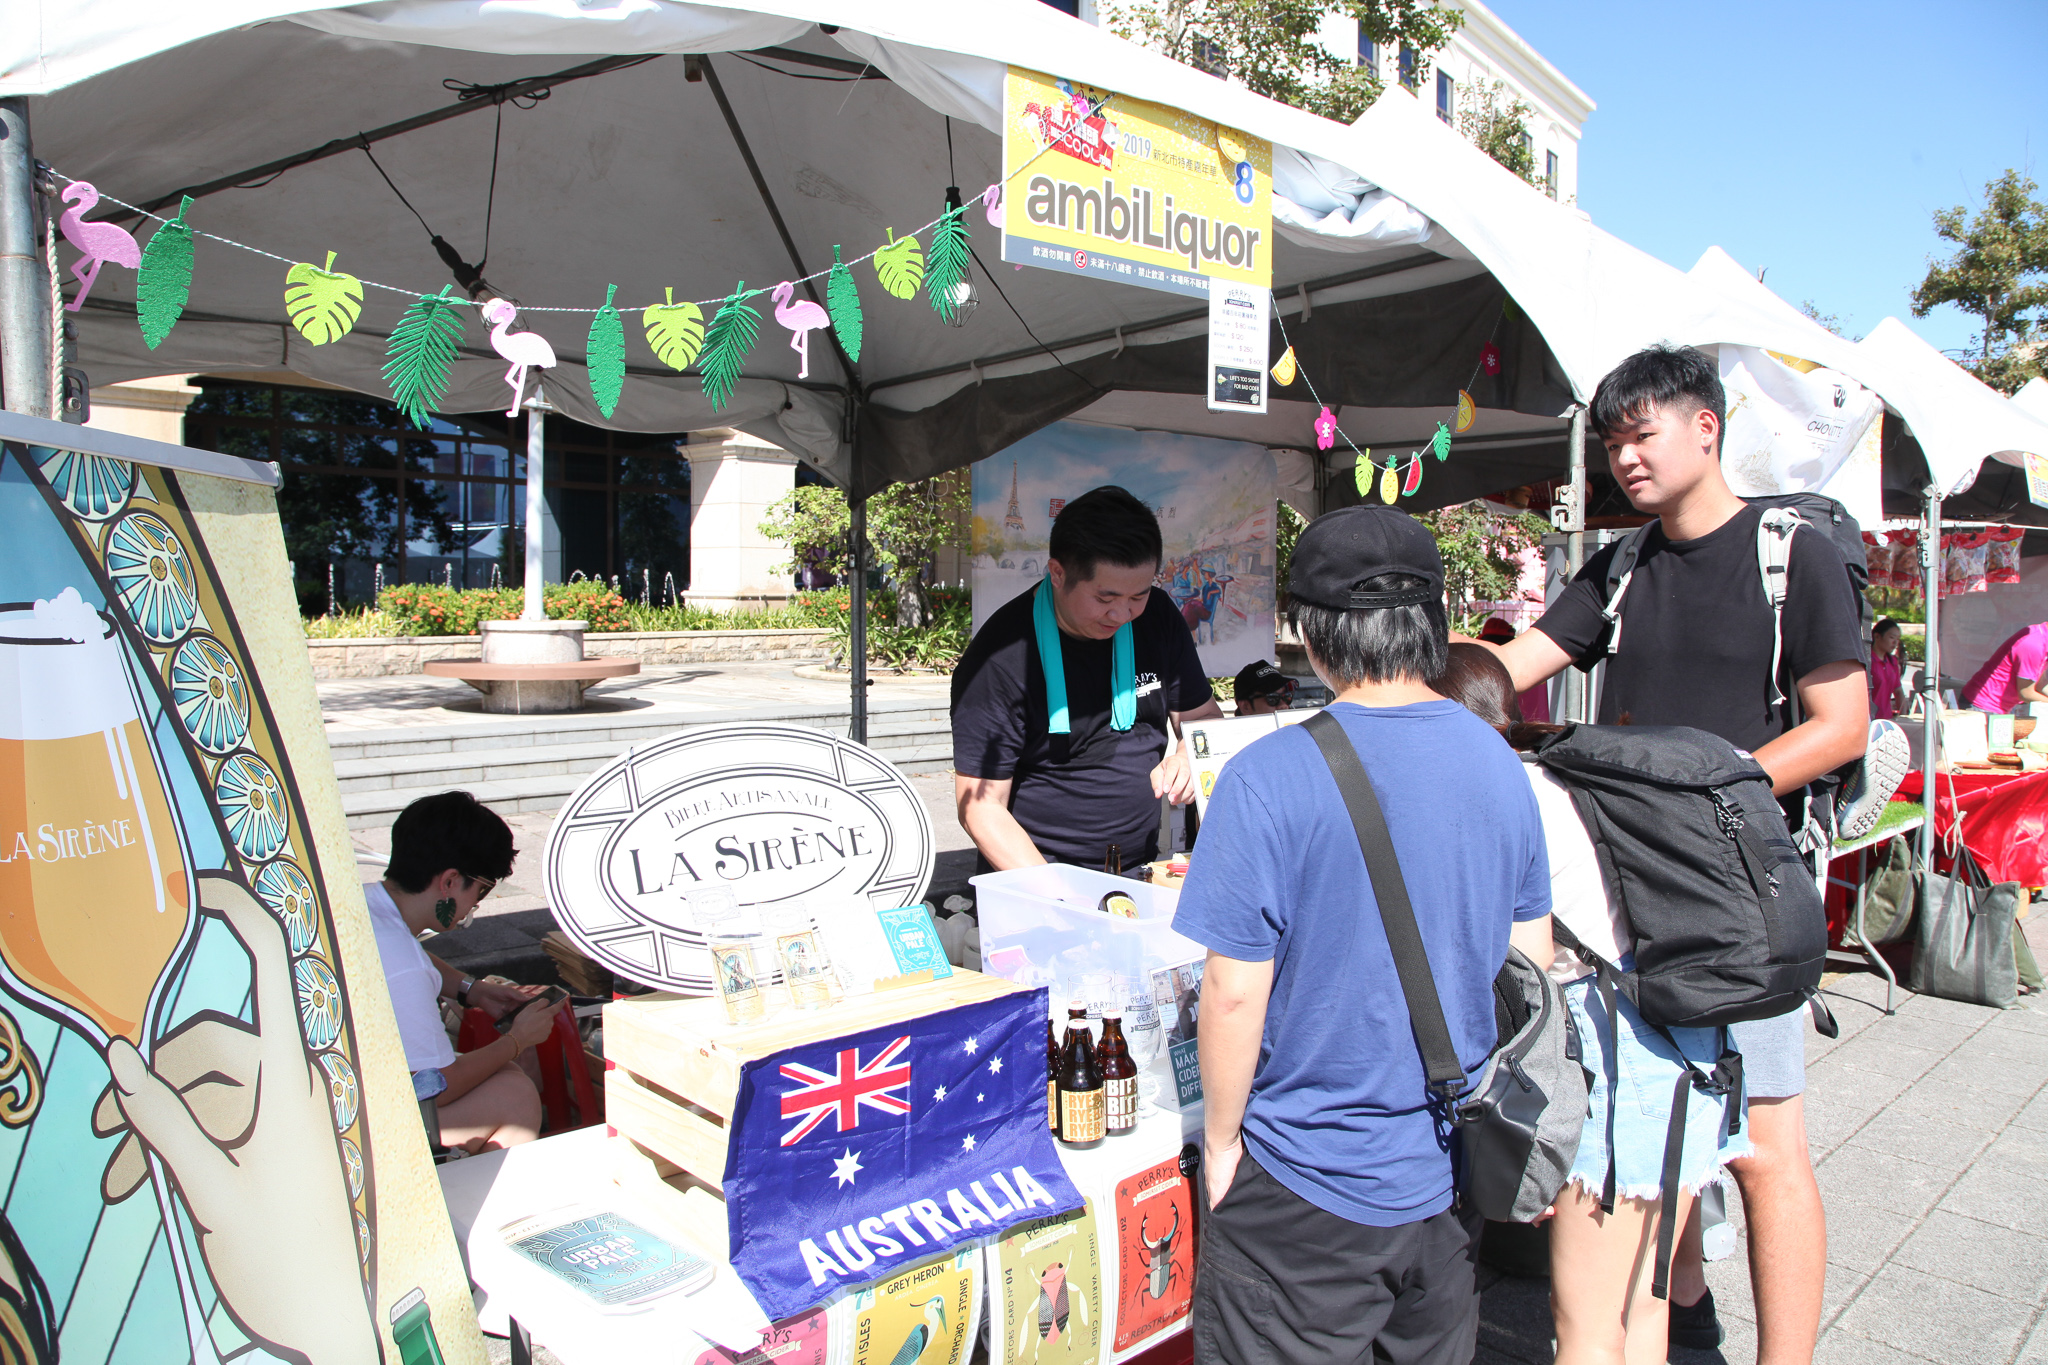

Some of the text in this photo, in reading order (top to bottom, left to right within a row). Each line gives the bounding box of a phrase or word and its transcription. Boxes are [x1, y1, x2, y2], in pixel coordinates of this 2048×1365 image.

[1124, 133, 1217, 177] 2019 新北市特產嘉年華
[1236, 161, 1254, 204] 8
[1027, 176, 1259, 270] ambiLiquor
[1032, 245, 1072, 264] 飲酒勿開車
[719, 789, 833, 811] ARTISANALE
[37, 819, 137, 863] SIRÈNE
[630, 824, 873, 896] LA SIRÈNE
[898, 930, 926, 942] URBAN
[904, 938, 926, 950] PALE
[1178, 1152, 1199, 1169] taste
[1138, 1166, 1174, 1191] PERRY'S
[1139, 1179, 1174, 1200] SOMERSET CIDER
[799, 1165, 1056, 1288] AUSTRALIA
[1025, 1213, 1069, 1241] PERRY'S
[1120, 1216, 1128, 1233] 02
[561, 1235, 637, 1264] URBAN
[582, 1244, 643, 1270] PALE
[1088, 1232, 1097, 1268] SINGLE
[887, 1263, 945, 1295] GREY HERON
[1005, 1267, 1013, 1286] 04
[1119, 1273, 1129, 1326] COLLECTORS
[948, 1277, 969, 1365] SINGLE ORCHARD
[1091, 1319, 1099, 1348] CIDER
[1130, 1308, 1179, 1340] REDSTREAK
[858, 1317, 871, 1355] ISLES
[769, 1345, 790, 1358] CIDER
